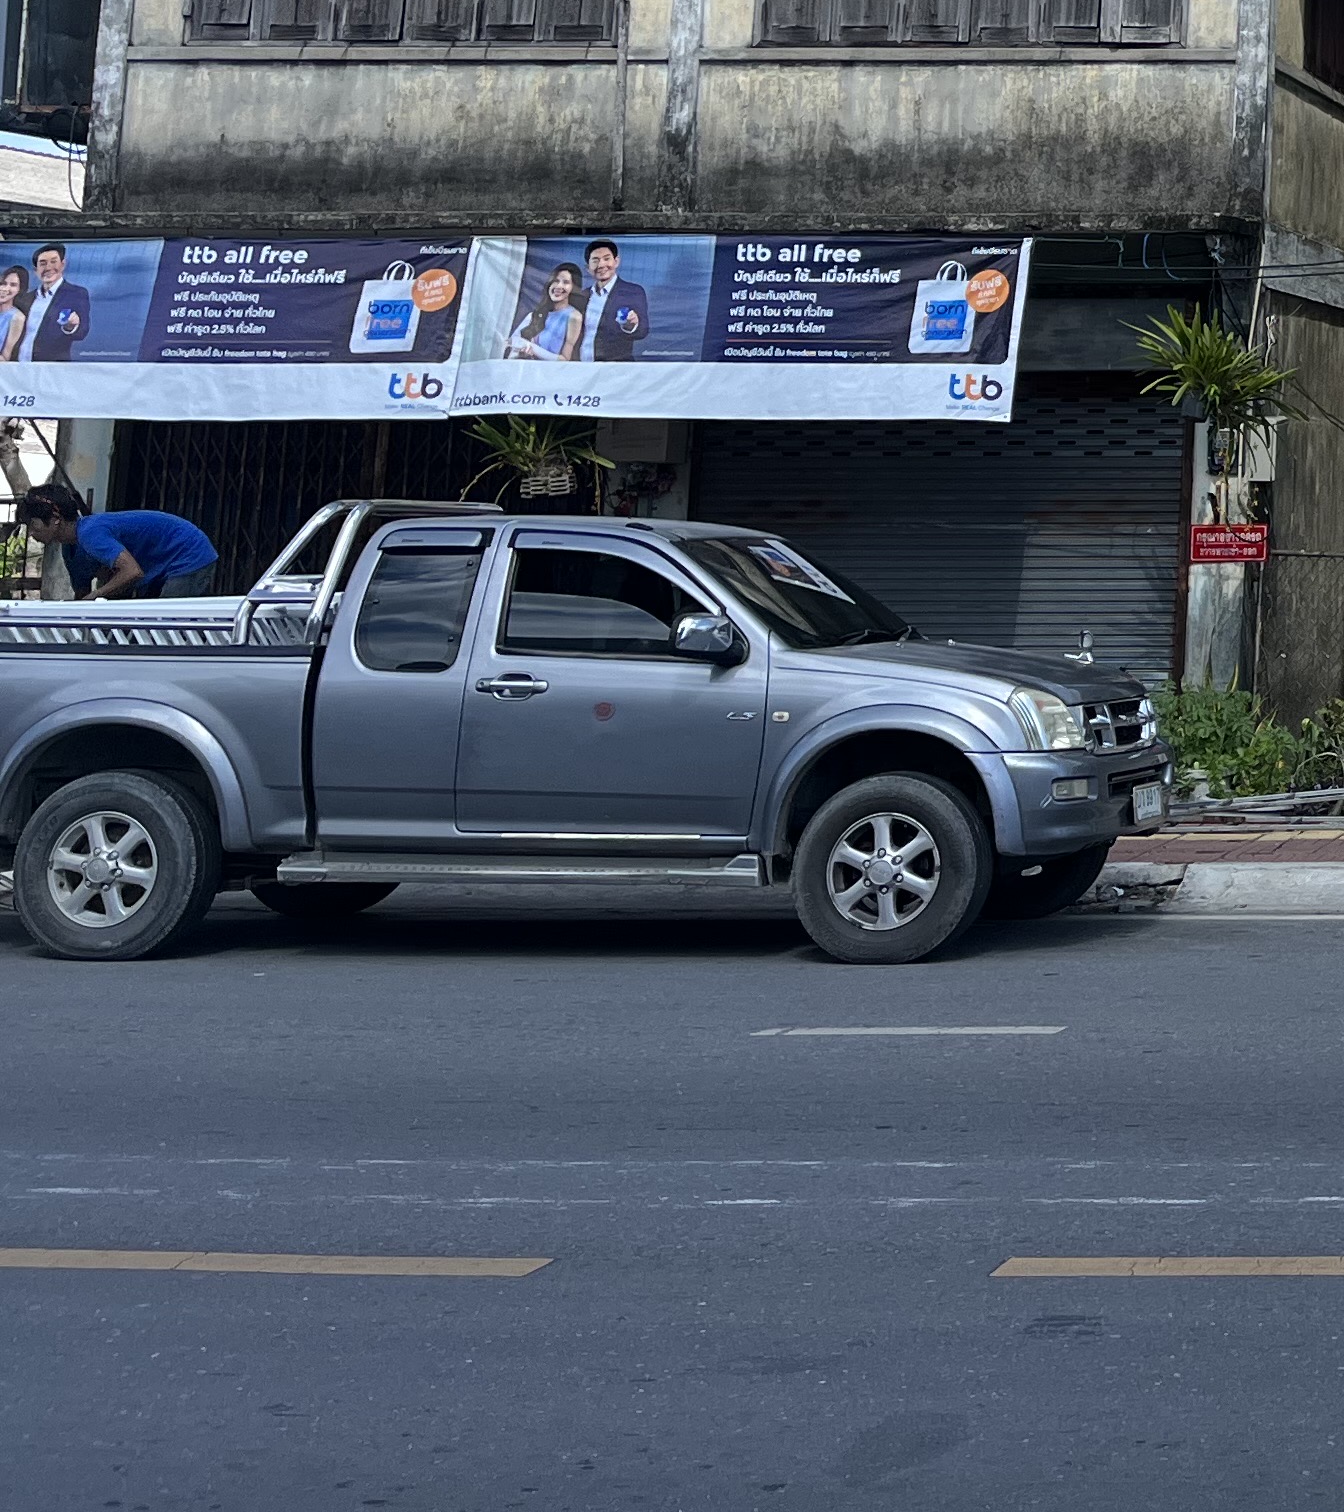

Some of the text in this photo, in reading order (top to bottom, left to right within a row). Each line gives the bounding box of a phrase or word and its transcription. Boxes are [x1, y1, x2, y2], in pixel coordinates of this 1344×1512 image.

[182, 245, 308, 264] ttb all free
[736, 244, 861, 262] ttb all free
[178, 270, 236, 286] บัญชีเดียว
[734, 270, 791, 284] บัญชีเดียว
[173, 291, 260, 304] ฟรี ประกันอุบัติเหตุ
[732, 289, 817, 303] ฟรี ประกันอุบัติเหตุ
[170, 307, 187, 318] ฟรี
[368, 301, 410, 315] born
[729, 306, 746, 317] ฟรี
[924, 301, 965, 315] born
[167, 323, 184, 334] ฟรี
[211, 325, 234, 334] 2.5%
[727, 322, 744, 333] ฟรี
[771, 324, 795, 333] 2.5%
[921, 316, 959, 329] free
[388, 373, 443, 399] ttb
[949, 374, 1003, 401] ttb
[3, 395, 36, 407] 1428
[454, 392, 601, 408] ttbbank.com 1428
